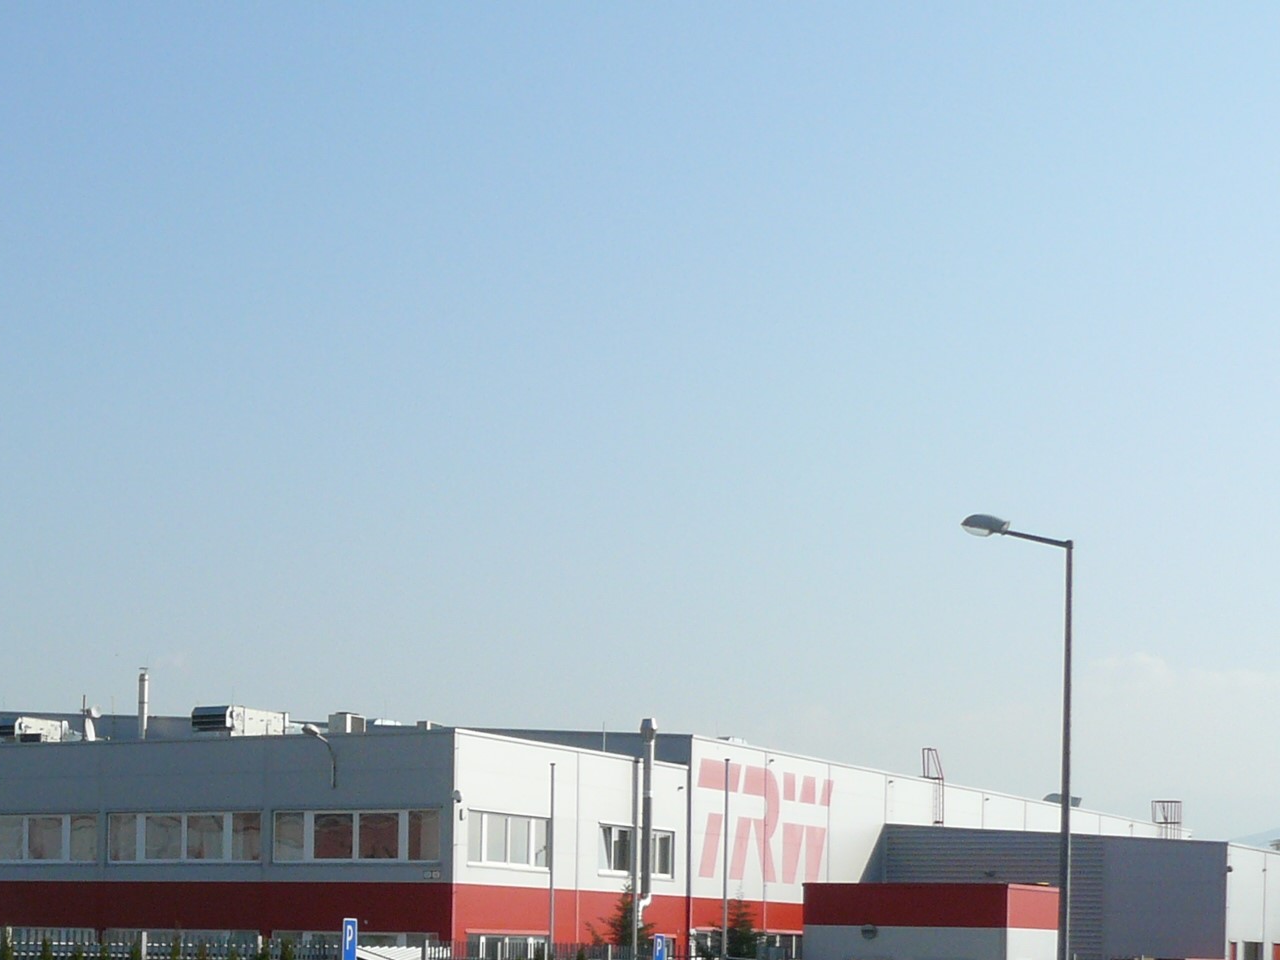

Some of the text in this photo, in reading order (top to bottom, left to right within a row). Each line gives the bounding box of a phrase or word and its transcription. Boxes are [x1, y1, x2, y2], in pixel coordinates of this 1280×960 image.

[697, 758, 834, 884] TRW
[346, 925, 353, 950] P
[656, 938, 662, 957] P
